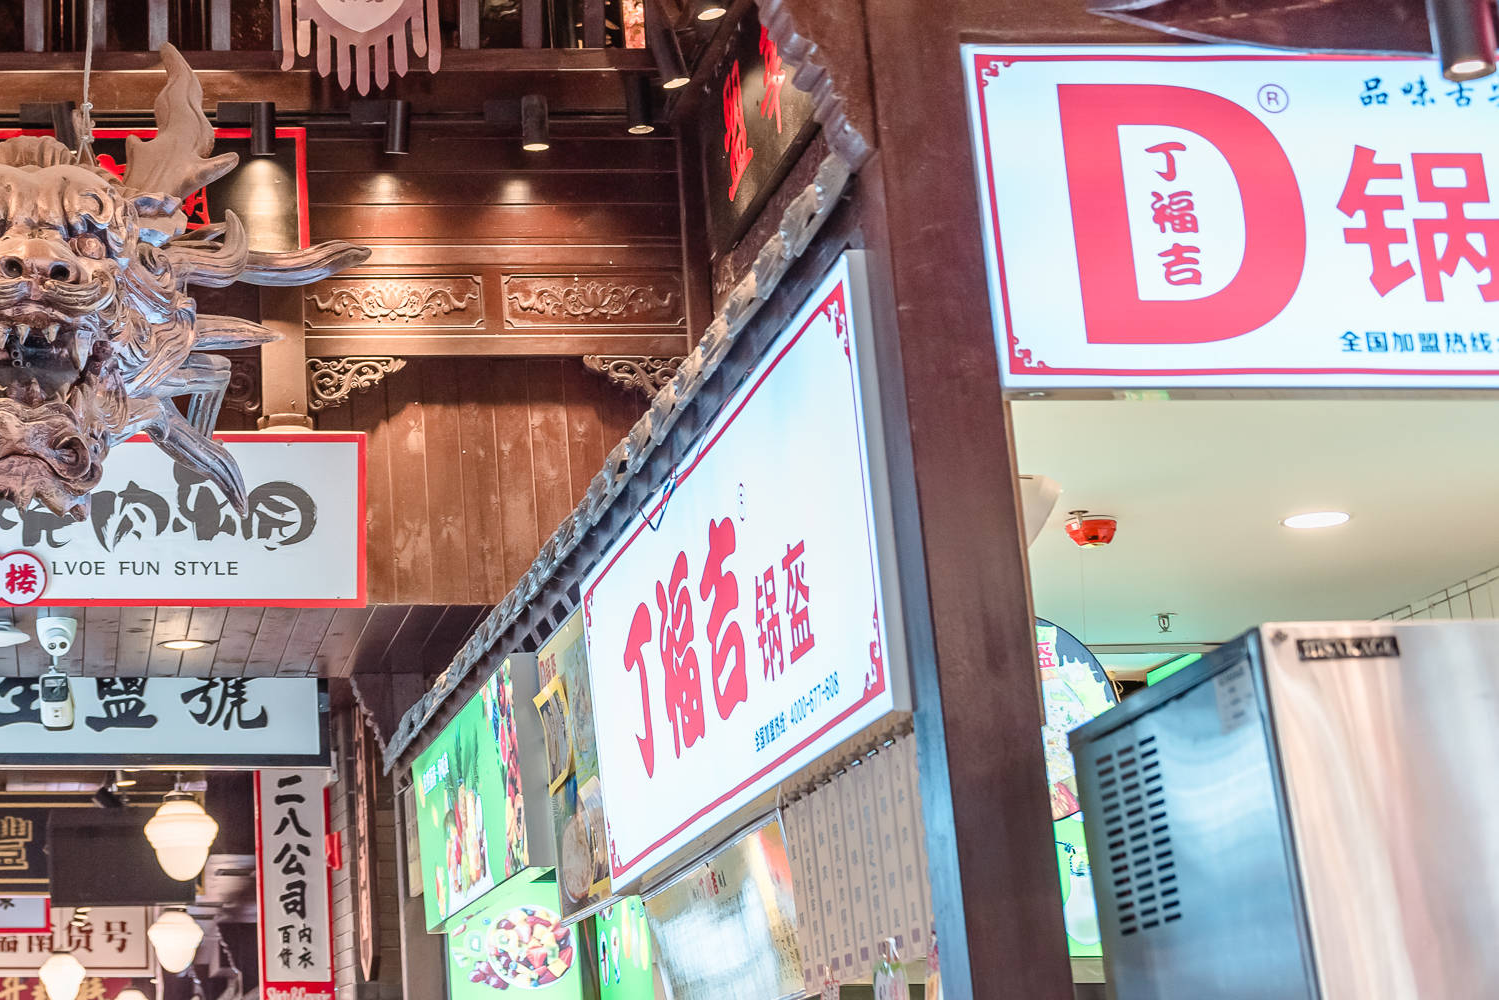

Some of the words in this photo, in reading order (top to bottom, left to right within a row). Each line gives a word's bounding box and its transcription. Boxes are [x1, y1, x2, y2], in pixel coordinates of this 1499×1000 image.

[1144, 141, 1203, 287] 丁福吉
[1336, 144, 1499, 303] 锅
[1339, 330, 1493, 354] 全国加盟热线
[52, 560, 106, 576] LVOE
[119, 560, 160, 576] FUN
[173, 560, 239, 576] STYLE
[623, 517, 748, 779] 丁福吉
[755, 539, 816, 682] 锅盔
[273, 775, 312, 920] 二八公司
